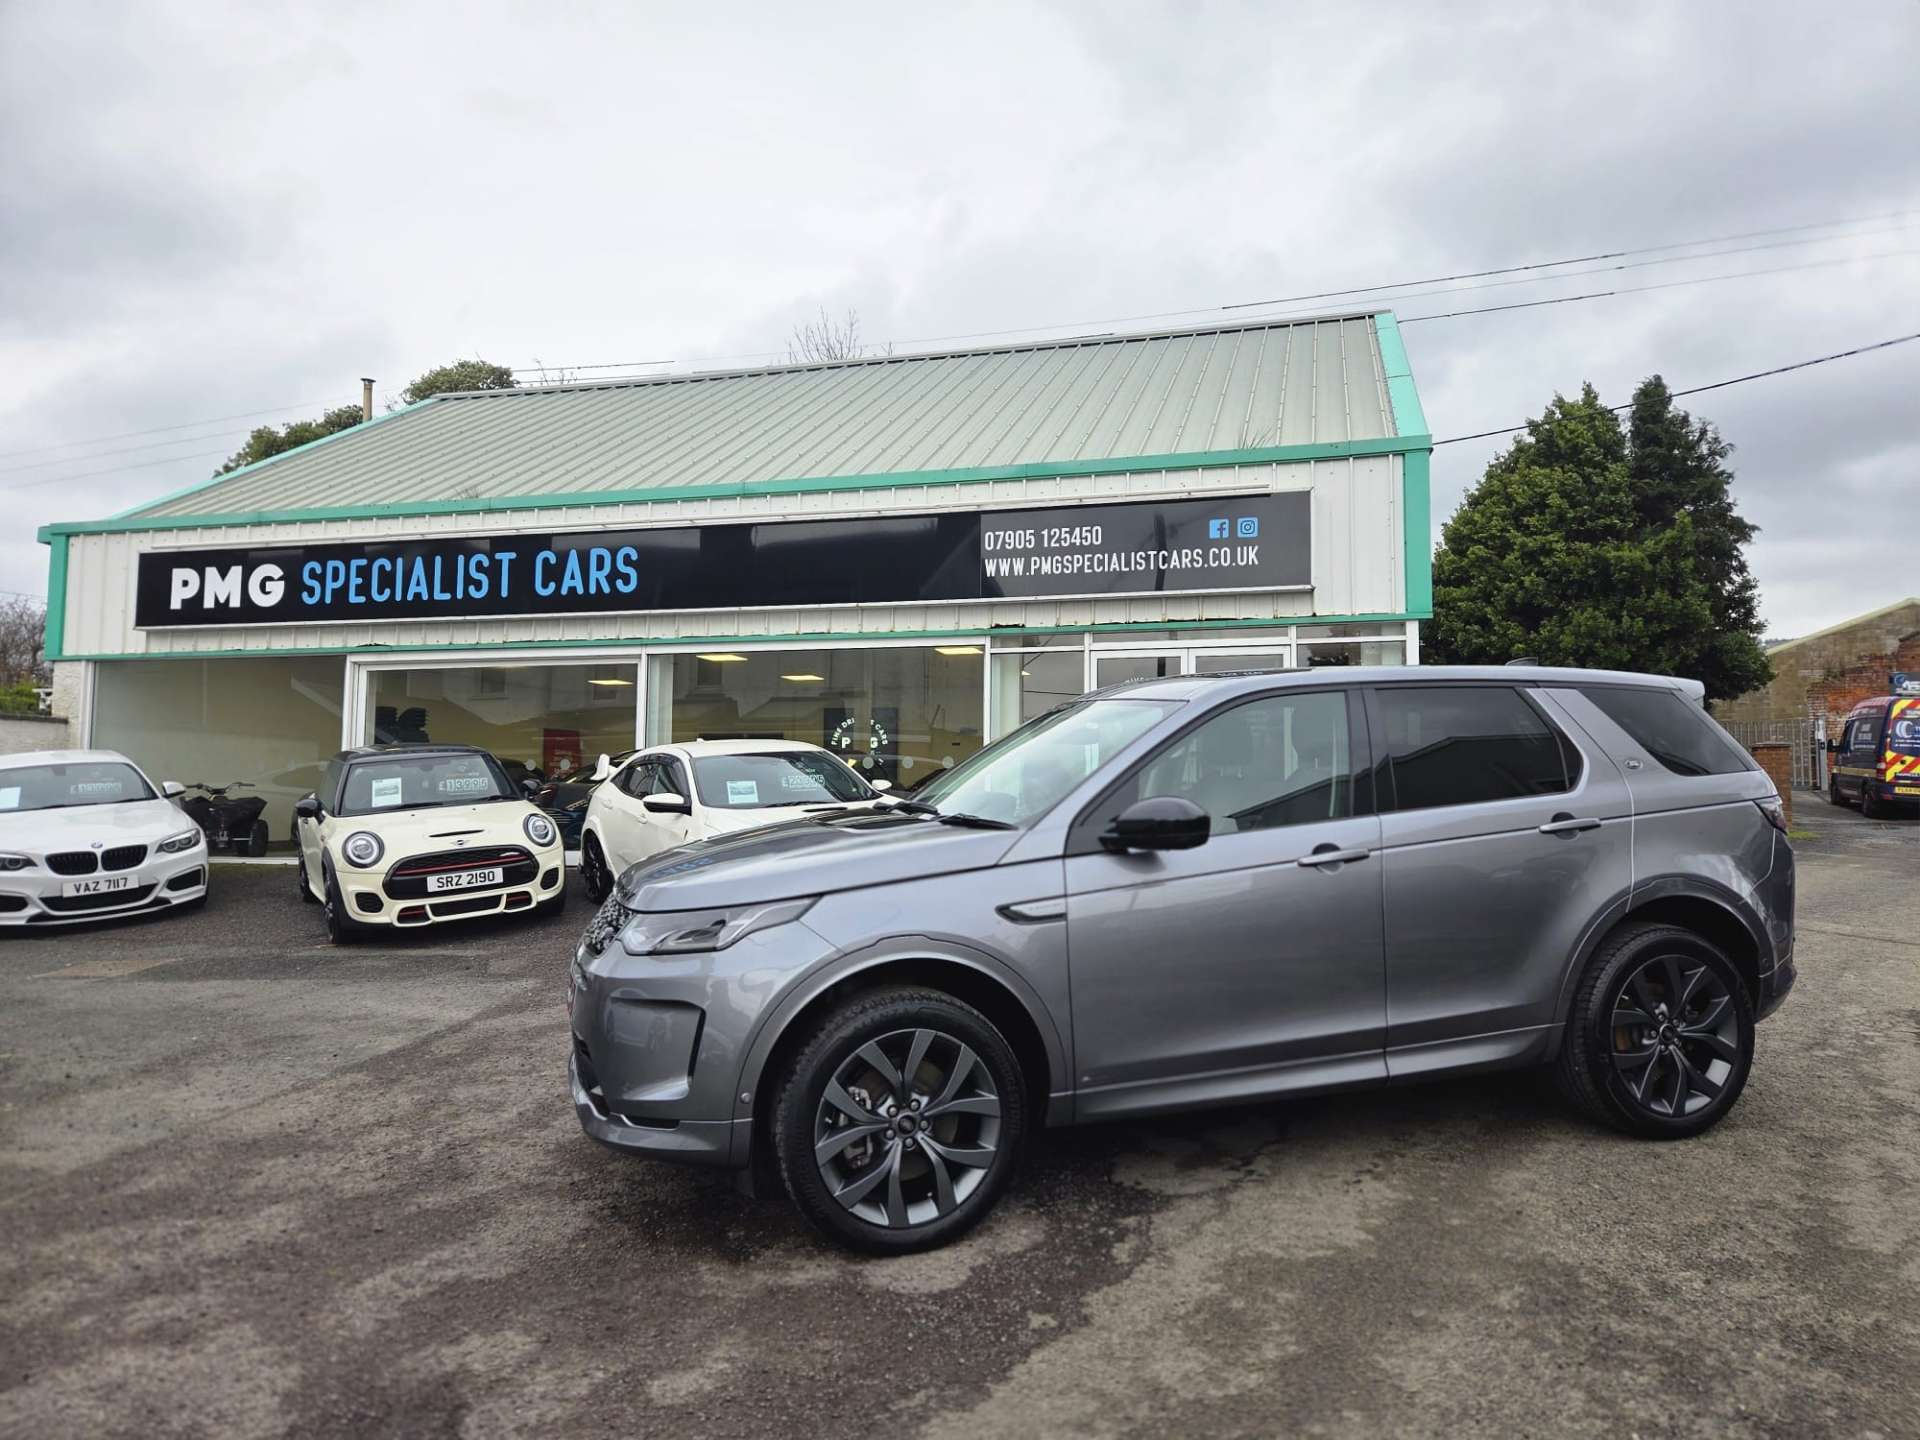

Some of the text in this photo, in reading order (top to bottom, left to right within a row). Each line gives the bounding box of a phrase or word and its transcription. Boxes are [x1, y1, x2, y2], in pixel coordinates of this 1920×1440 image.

[984, 525, 1102, 551] 07905 125450
[984, 545, 1259, 577] WWW.PMGSPECIALISTCARS.CO.UK
[170, 546, 638, 610] PMG SPECIALIST CARS
[73, 877, 129, 894] VAZ 7117
[436, 870, 495, 889] SRZ 2190
